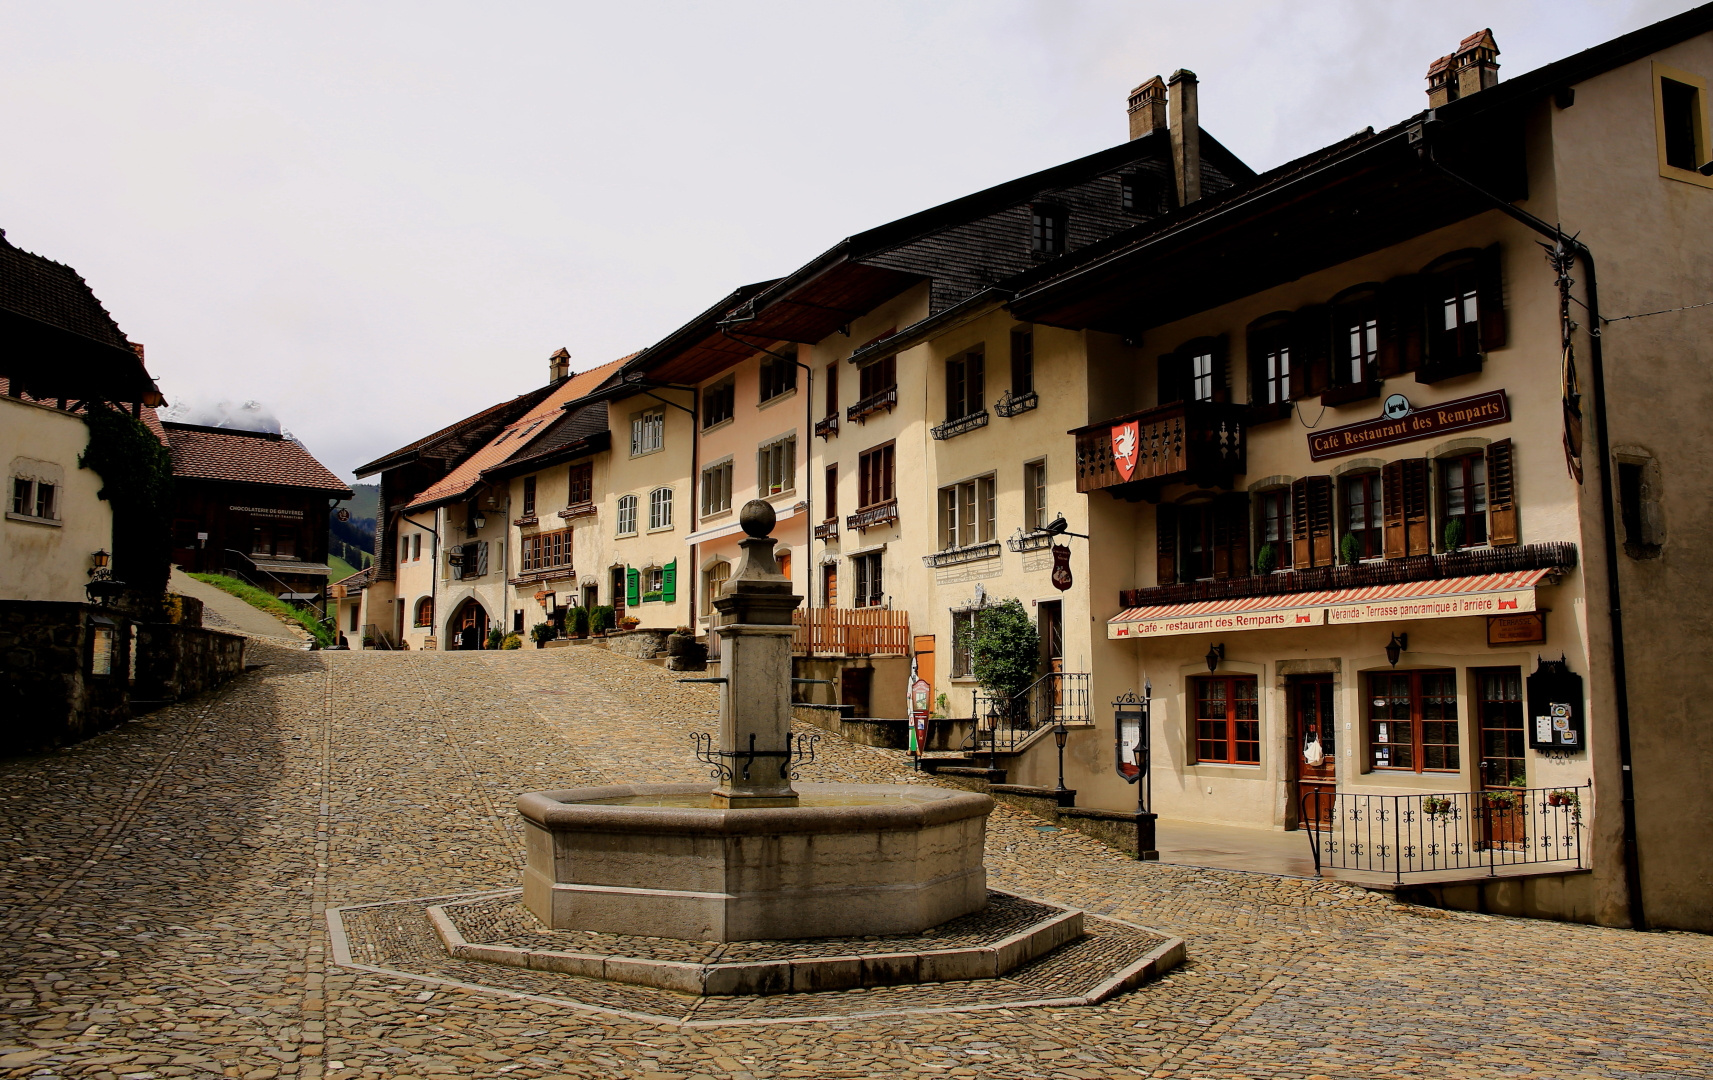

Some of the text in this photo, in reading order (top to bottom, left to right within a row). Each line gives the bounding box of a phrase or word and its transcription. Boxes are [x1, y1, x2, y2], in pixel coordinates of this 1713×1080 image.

[1314, 402, 1500, 451] Café Restaurant des Remparts
[229, 505, 269, 513] CHOCOLATERIE
[1331, 606, 1360, 620] Véranda
[1366, 605, 1398, 618] Terrasse
[1400, 600, 1450, 617] panoramique
[1452, 599, 1458, 611] à
[1459, 596, 1493, 611] l'arrière
[1138, 623, 1158, 634] Café
[1165, 619, 1213, 631] restaurant
[1215, 615, 1233, 628] des
[1236, 614, 1285, 627] Remparts
[1499, 617, 1533, 626] TERRASSE
